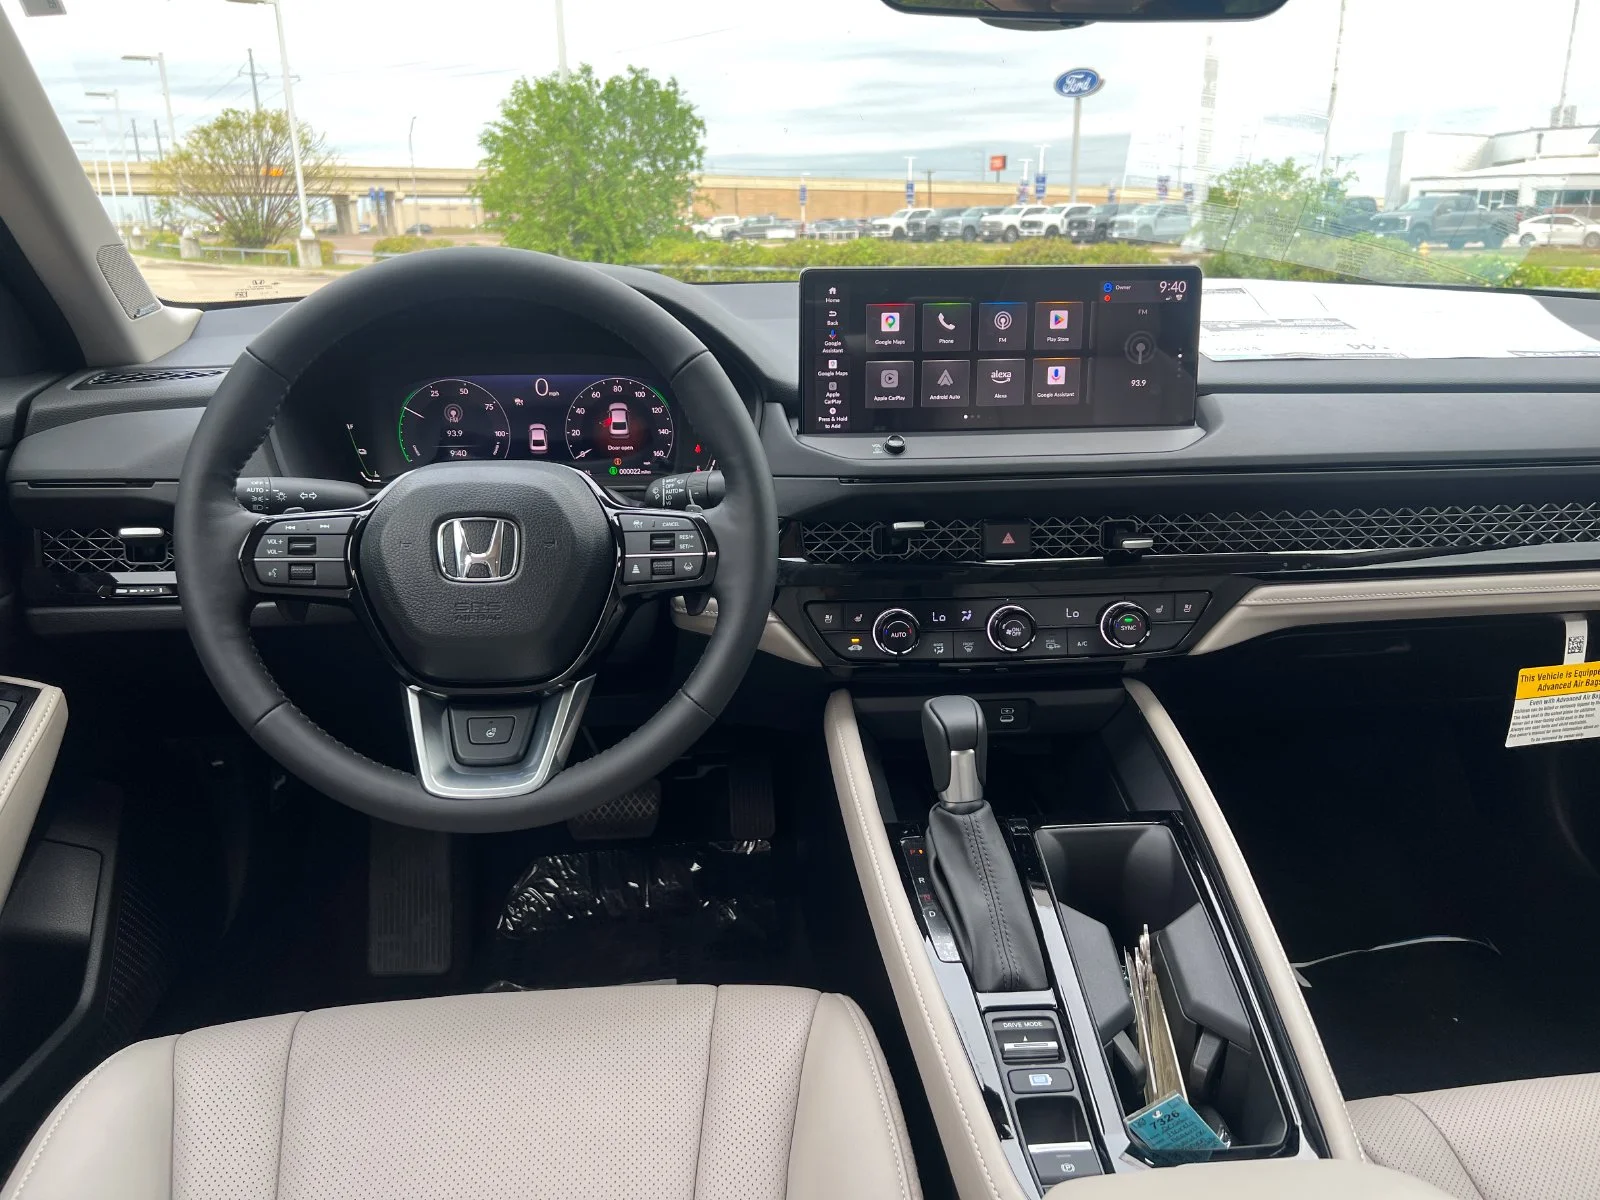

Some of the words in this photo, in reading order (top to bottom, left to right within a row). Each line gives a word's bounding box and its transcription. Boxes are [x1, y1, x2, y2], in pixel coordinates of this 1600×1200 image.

[1063, 74, 1092, 93] Ford
[1160, 281, 1186, 292] 9:40
[991, 370, 1011, 378] alexa
[534, 378, 548, 396] 0
[932, 612, 946, 622] Lo
[1066, 608, 1079, 618] Lo
[1538, 672, 1563, 680] Vehicle
[1537, 681, 1571, 692] Advanced
[1150, 1110, 1180, 1130] 7326
